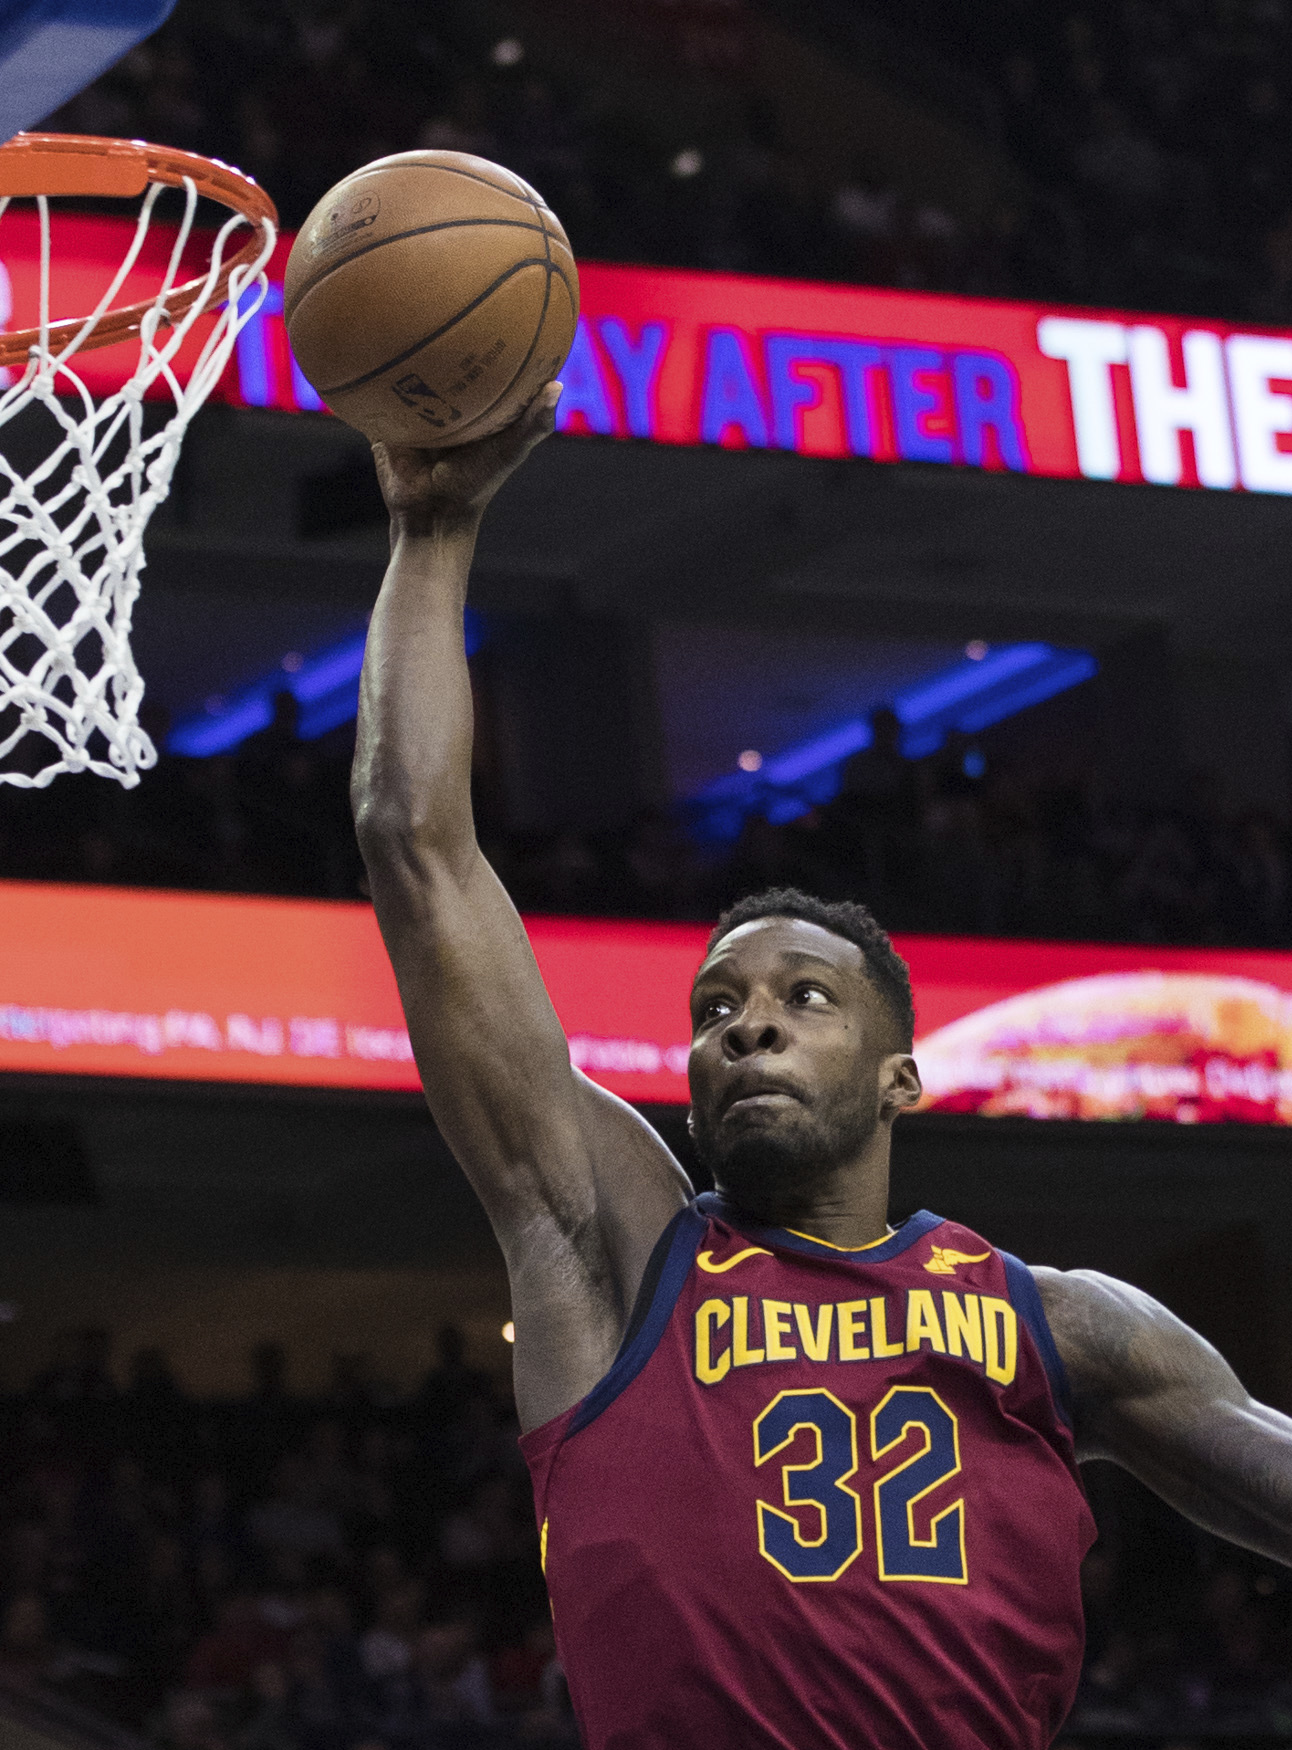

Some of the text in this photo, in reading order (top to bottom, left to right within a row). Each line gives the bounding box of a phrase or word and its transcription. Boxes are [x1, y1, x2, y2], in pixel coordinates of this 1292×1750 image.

[554, 315, 665, 438] AY
[702, 323, 1030, 473] AFTER
[695, 1289, 1018, 1387] CLEVELAND
[752, 1385, 969, 1585] 32
